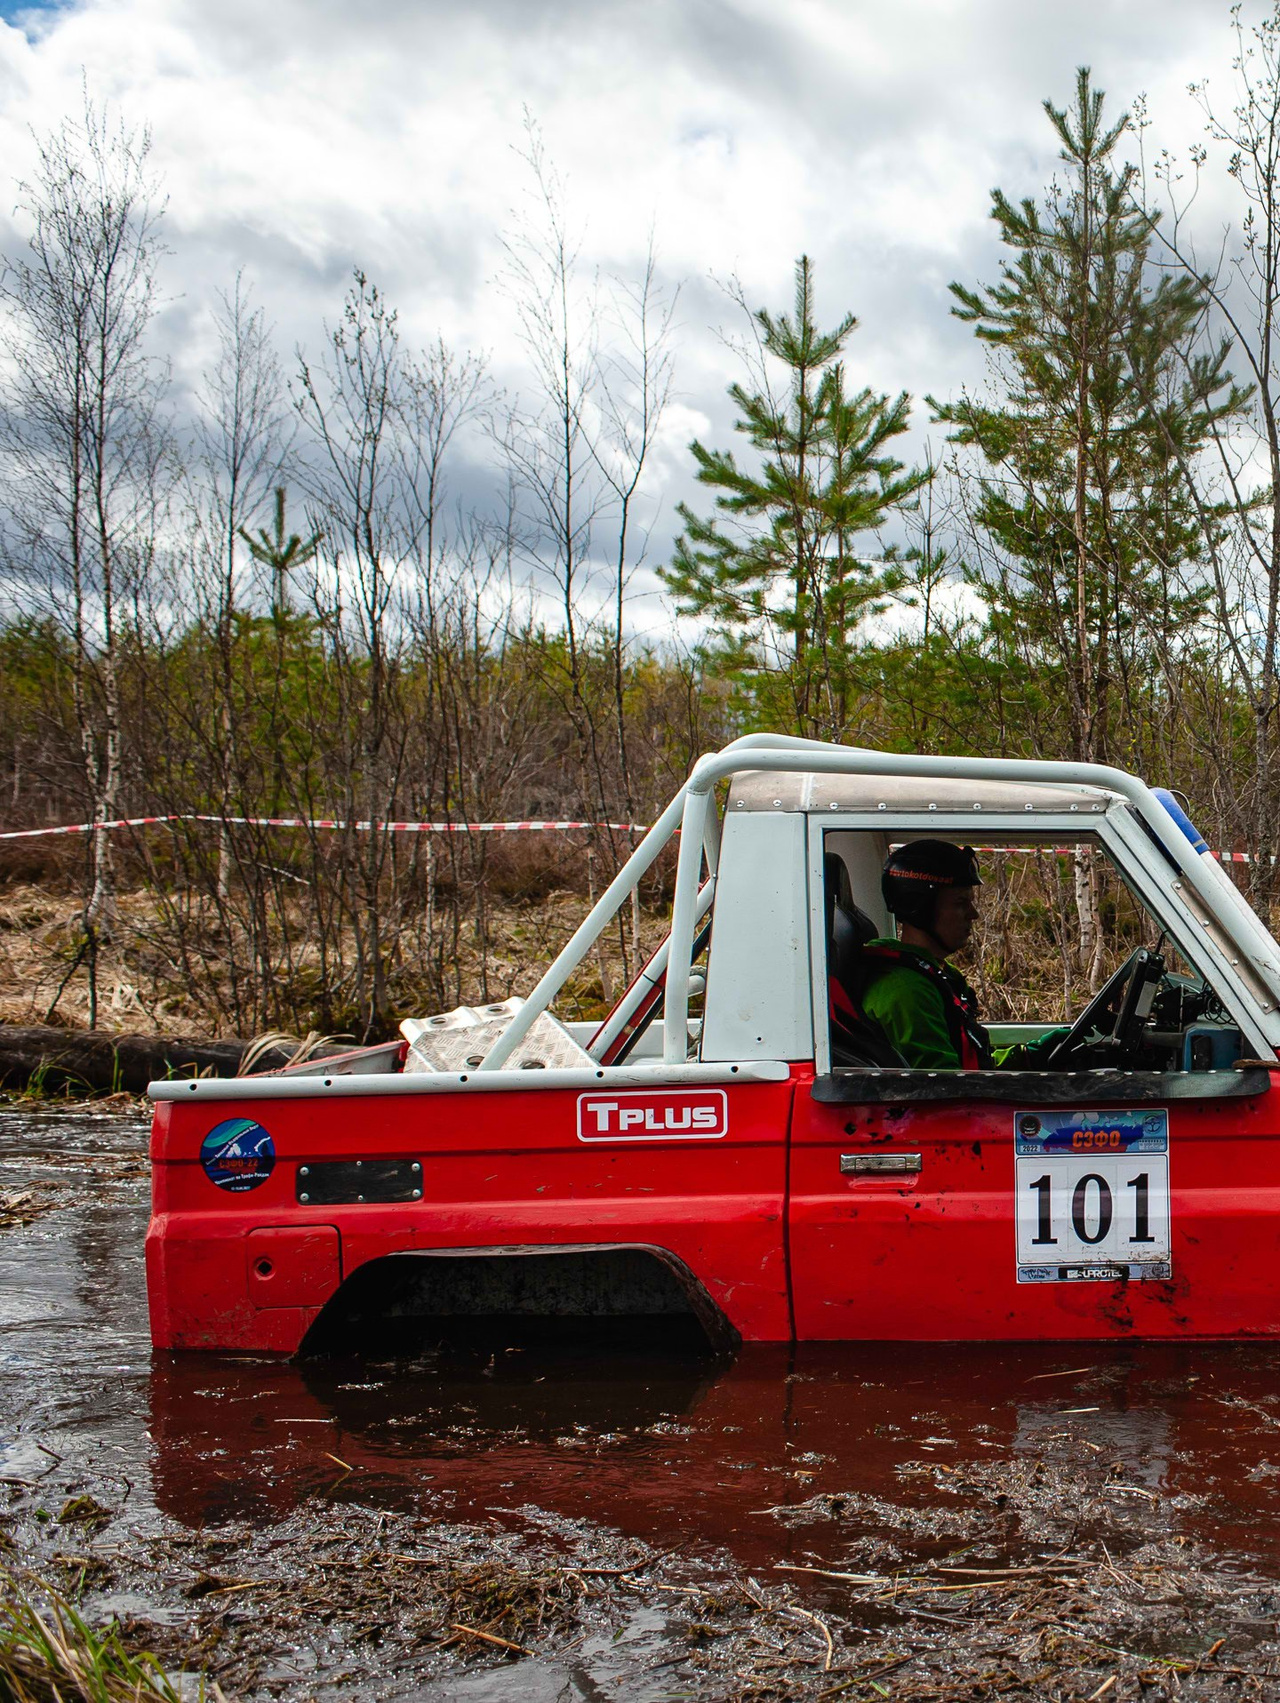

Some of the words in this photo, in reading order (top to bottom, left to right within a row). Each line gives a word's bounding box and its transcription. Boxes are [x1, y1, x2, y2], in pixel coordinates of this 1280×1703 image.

[587, 1103, 718, 1131] TPLUS
[1072, 1130, 1121, 1148] СЗФО
[1029, 1172, 1155, 1245] 101
